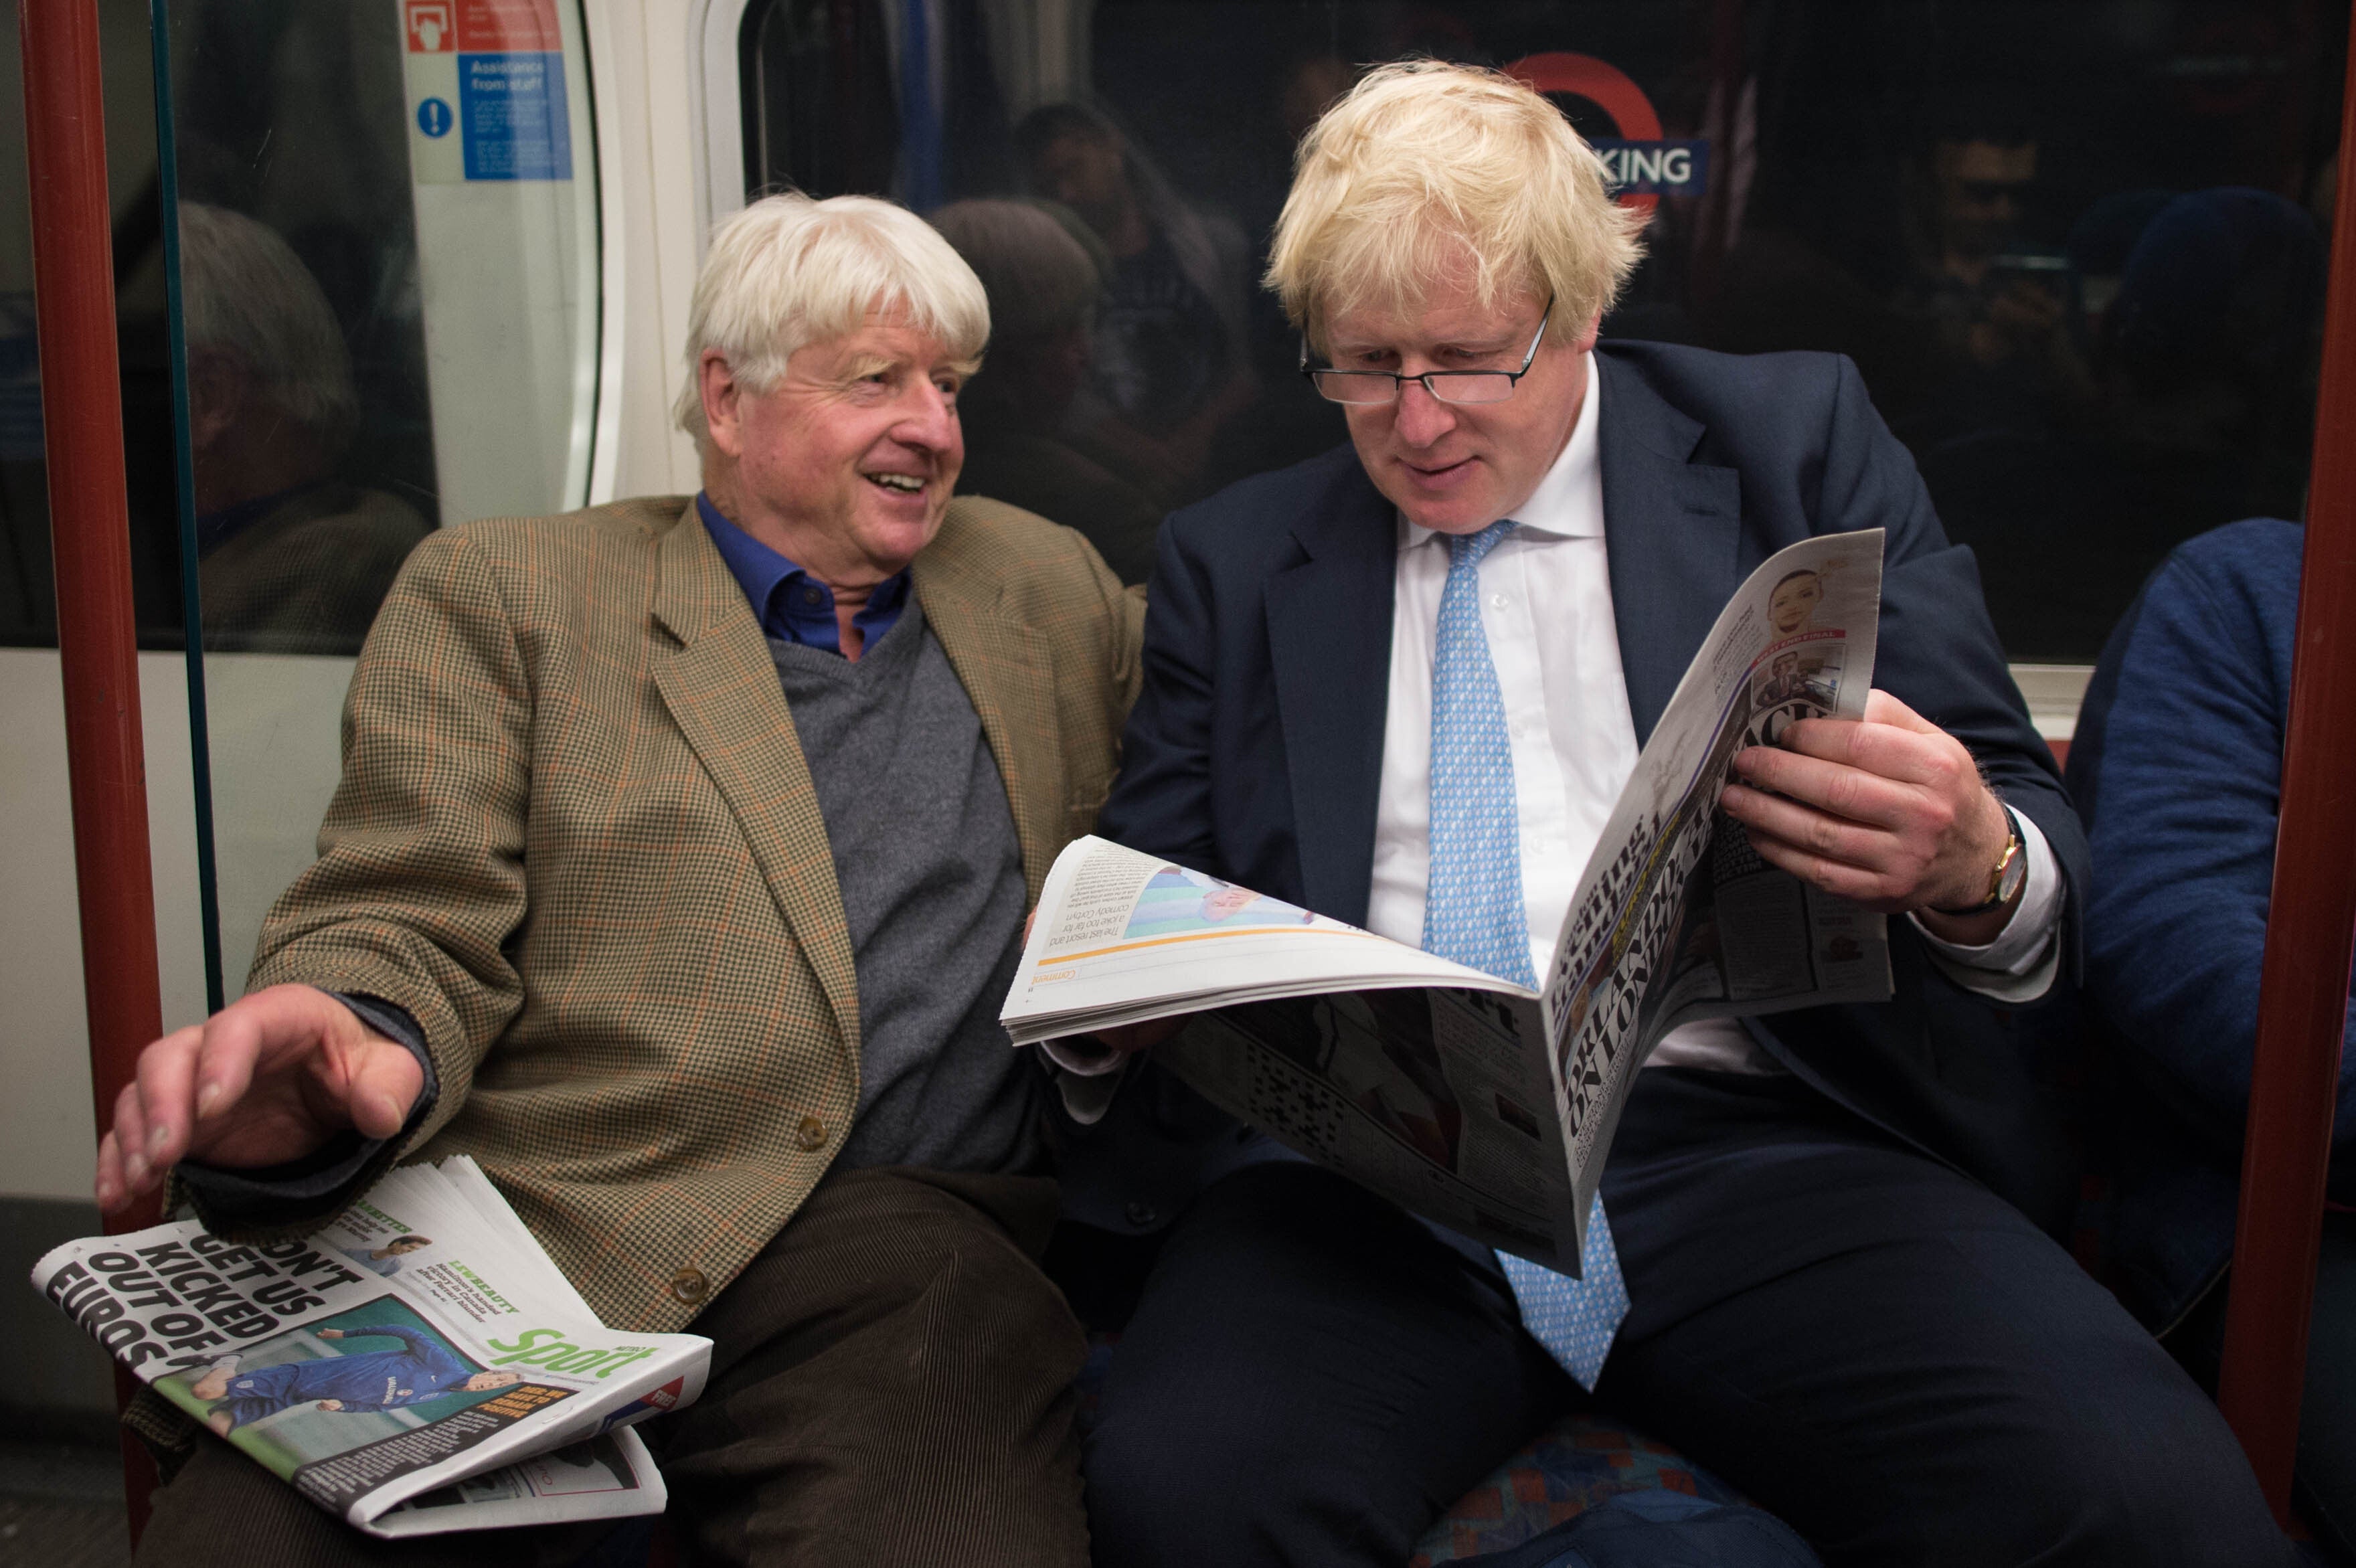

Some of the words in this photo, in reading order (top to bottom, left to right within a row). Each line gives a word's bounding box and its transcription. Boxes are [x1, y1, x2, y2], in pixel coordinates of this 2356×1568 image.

[470, 60, 543, 74] Assistance
[470, 78, 505, 91] from
[508, 78, 542, 91] staff
[1598, 148, 1691, 185] KING
[1066, 909, 1094, 921] Corbyn
[1095, 903, 1130, 916] comedy
[1074, 922, 1086, 931] far
[1086, 920, 1100, 928] too
[1101, 916, 1119, 925] joke
[1062, 924, 1074, 933] for
[1089, 929, 1103, 939] last
[1104, 926, 1119, 936] The
[1049, 937, 1066, 948] and
[1067, 932, 1088, 942] resort
[1031, 969, 1076, 986] Comment
[1571, 1053, 1602, 1138] ON
[259, 1240, 365, 1292] ON'T
[190, 1235, 280, 1282] GET
[252, 1280, 326, 1316] US
[135, 1241, 280, 1338] KICKED
[426, 1266, 453, 1285] victory
[452, 1284, 461, 1292] in
[459, 1291, 487, 1314] Canada
[88, 1251, 183, 1308] OUT
[151, 1313, 228, 1352] OF
[434, 1280, 459, 1300] Ferrari
[457, 1300, 487, 1323] blunder
[46, 1261, 169, 1367] EUROS
[487, 1328, 660, 1379] Sport
